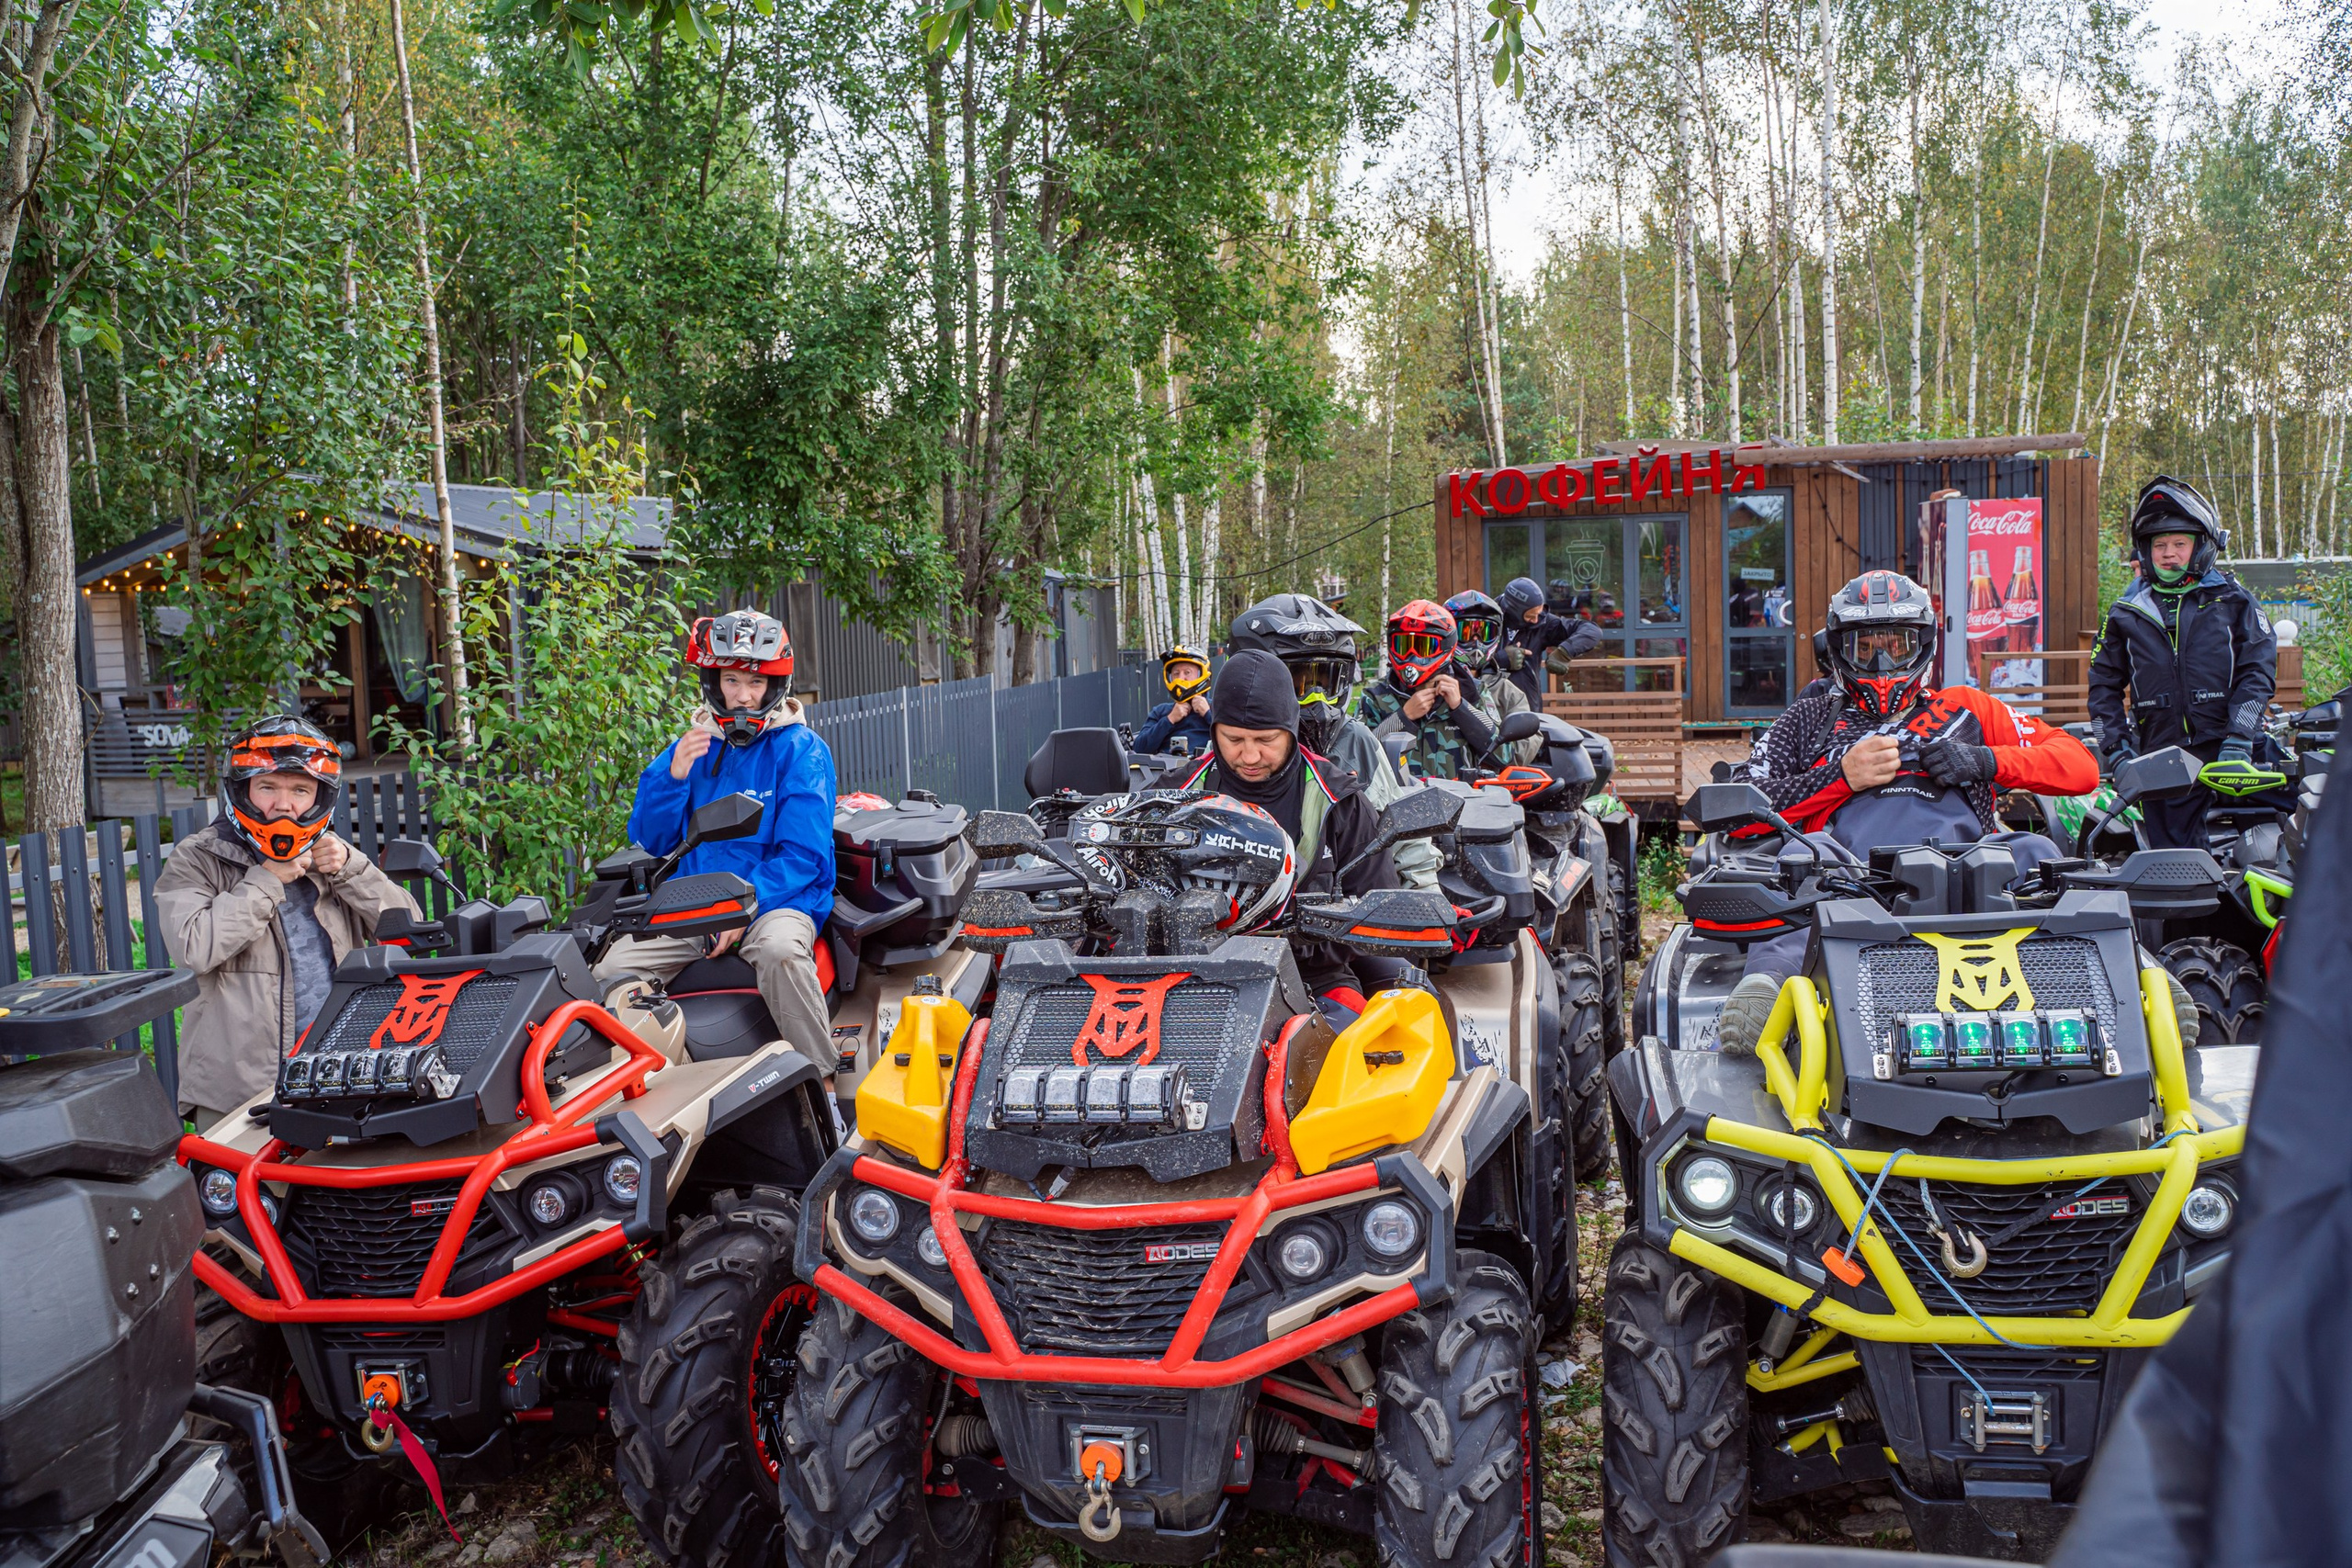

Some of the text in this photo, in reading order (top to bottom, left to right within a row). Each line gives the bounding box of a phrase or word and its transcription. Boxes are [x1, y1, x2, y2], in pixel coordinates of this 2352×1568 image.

[1449, 444, 1766, 518] КОФЕЙНЯ
[1082, 793, 1132, 818] Airoh
[1880, 787, 1936, 798] FINNTRAIL
[1204, 833, 1282, 861] KATANA
[1076, 845, 1117, 886] Airoh
[1148, 1242, 1221, 1261] AODES
